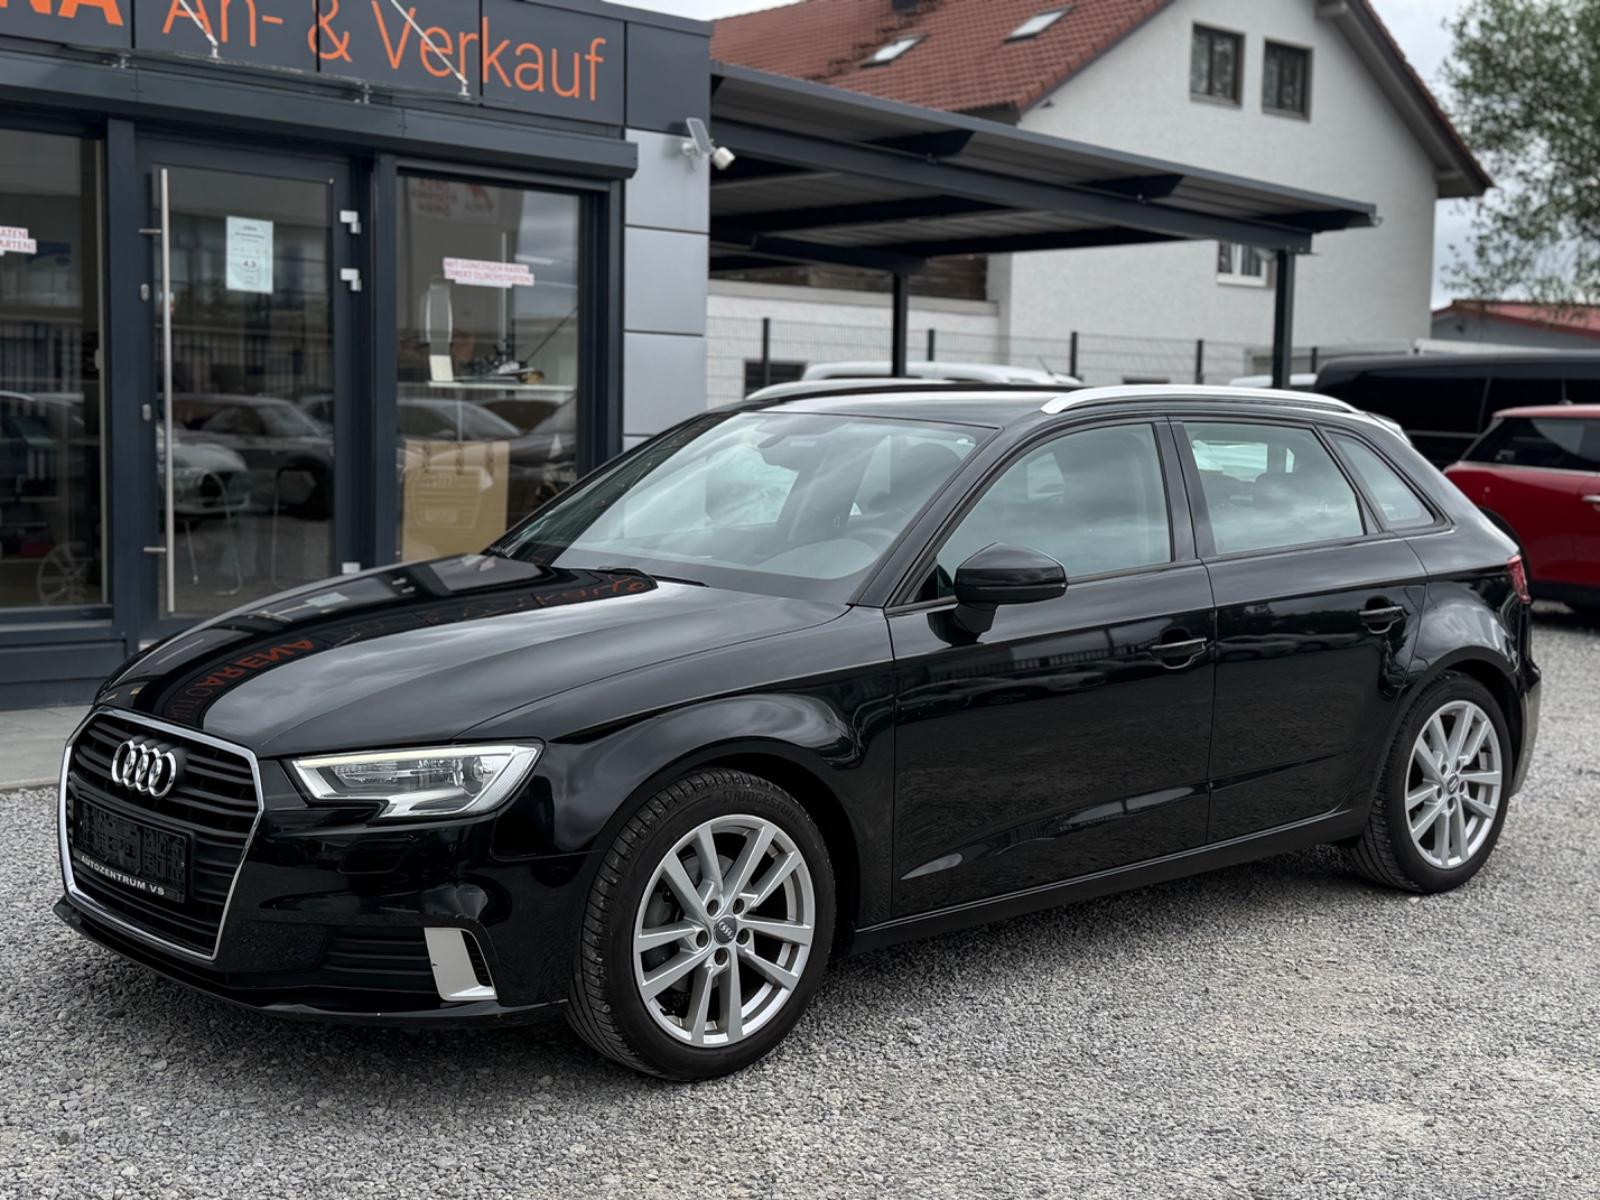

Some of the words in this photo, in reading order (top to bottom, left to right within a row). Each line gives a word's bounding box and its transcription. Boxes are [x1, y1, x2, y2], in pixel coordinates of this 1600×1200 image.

[162, 0, 284, 47] An-
[308, 0, 352, 63] &
[371, 0, 606, 101] Verkauf
[81, 855, 146, 890] AUTOZENTRUM
